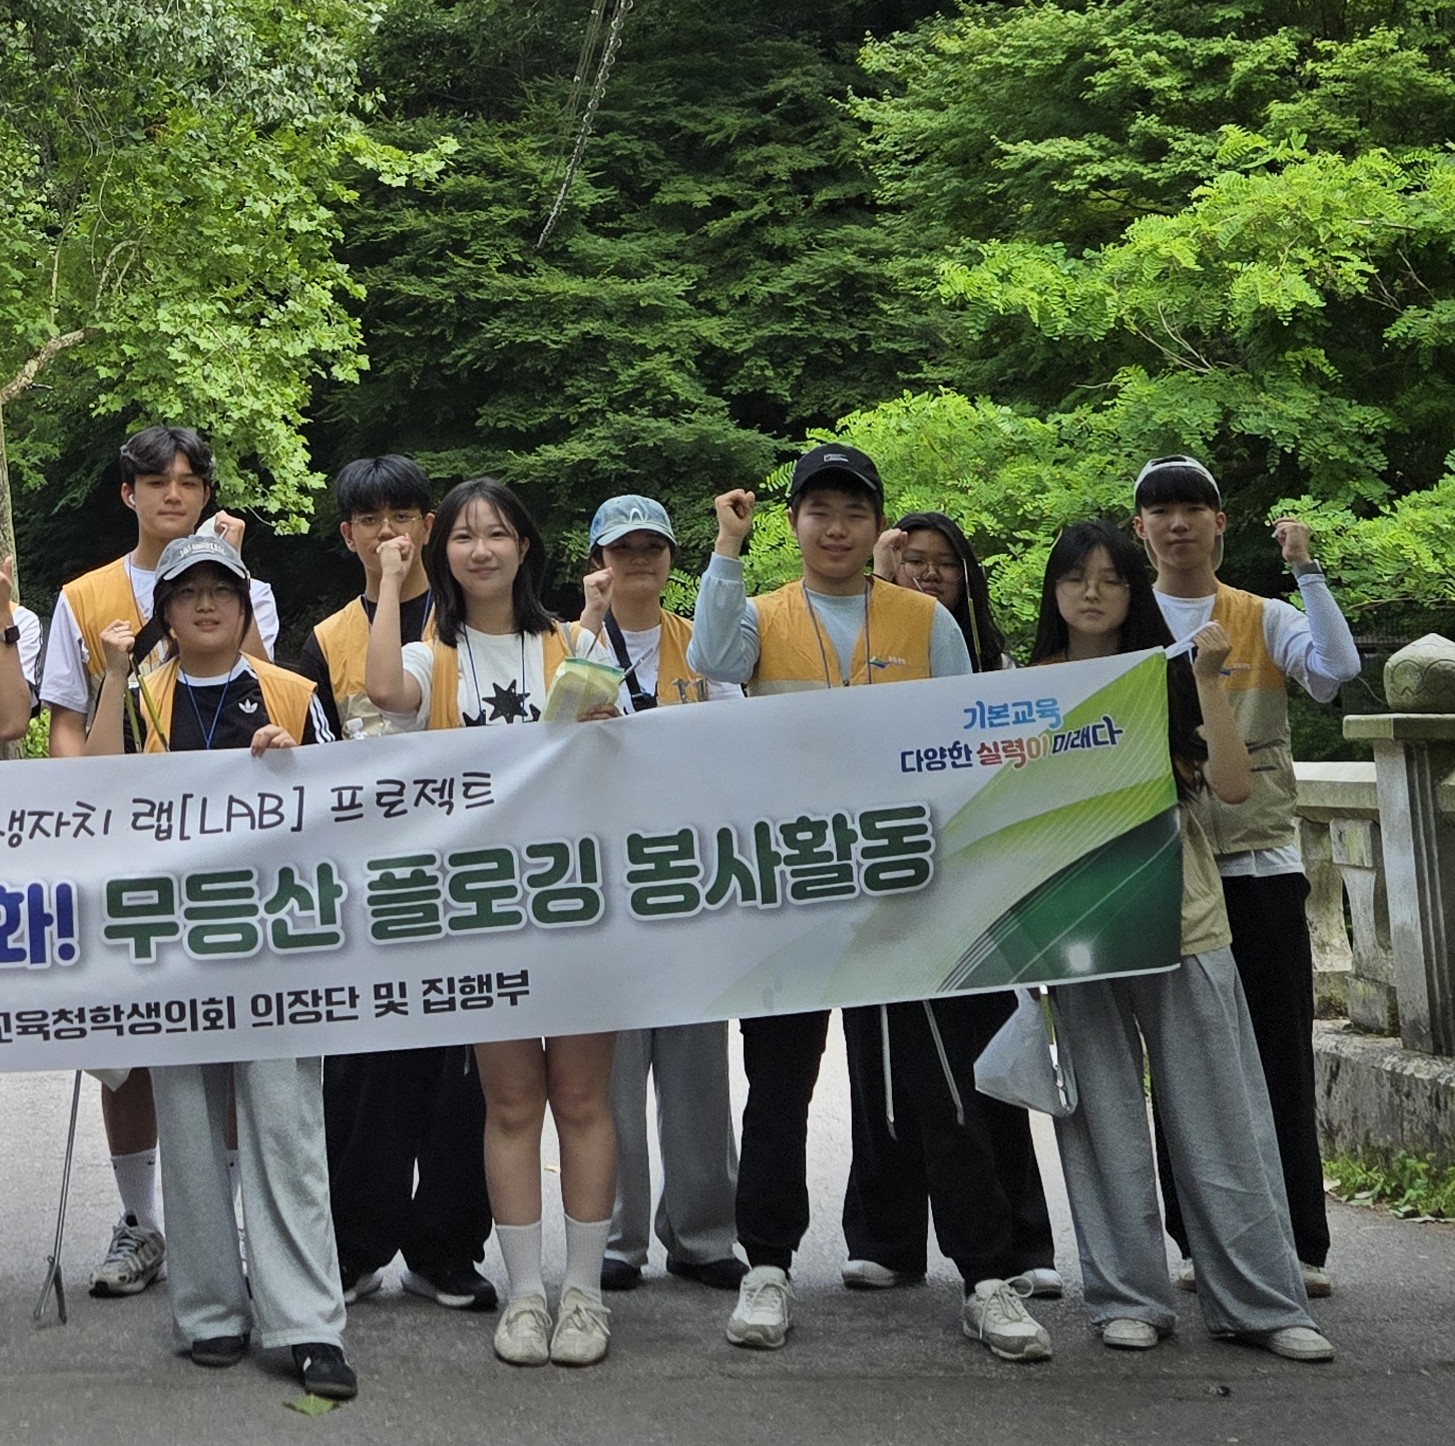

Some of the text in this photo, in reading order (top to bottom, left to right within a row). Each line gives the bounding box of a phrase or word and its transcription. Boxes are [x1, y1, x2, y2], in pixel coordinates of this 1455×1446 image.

[962, 697, 1063, 730] 기본교육
[900, 715, 1124, 773] 다양한 실력이 미래다
[131, 785, 306, 842] 랩[LAB]
[330, 772, 495, 824] 프로젝트
[103, 863, 344, 961] 무등산
[366, 837, 602, 942] 플로깅
[626, 804, 933, 917] 봉사활동
[250, 986, 362, 1029] 의장단
[374, 982, 410, 1018] 및
[422, 970, 532, 1016] 집행부
